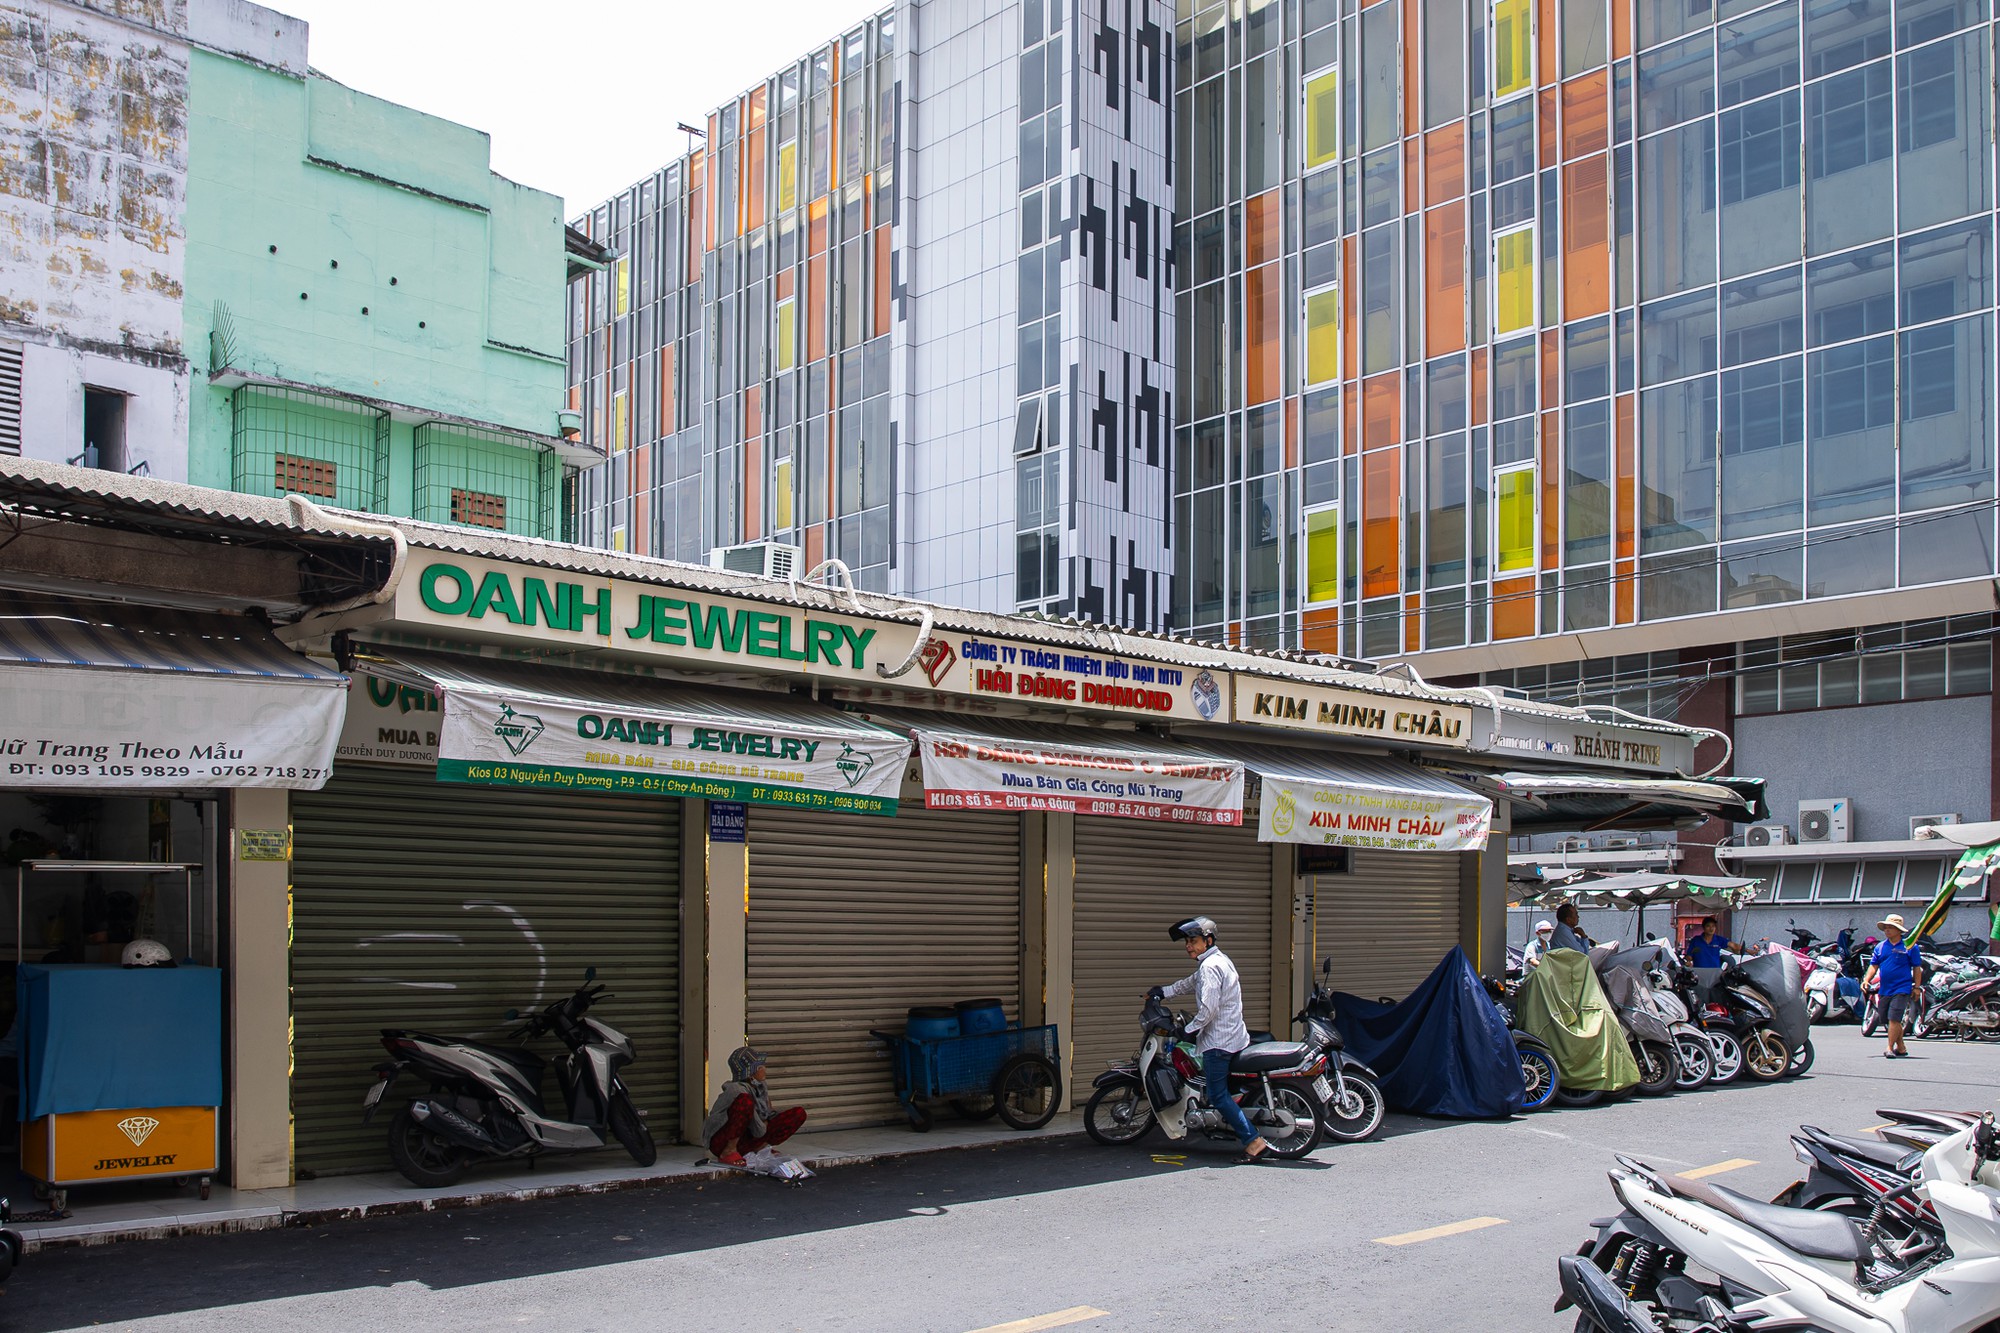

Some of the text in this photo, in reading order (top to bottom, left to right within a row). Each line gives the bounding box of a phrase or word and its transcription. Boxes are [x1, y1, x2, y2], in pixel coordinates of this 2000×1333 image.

[420, 563, 877, 670] OANH JEWELRY
[961, 640, 997, 662] CÔNG
[1000, 646, 1017, 665] TY
[1021, 648, 1061, 670] TRÁCH
[1063, 655, 1101, 678] NHIỆM
[1105, 656, 1129, 680] HỮU
[1132, 664, 1155, 686] HẠN
[976, 663, 1173, 712] HẢI ĐĂNG DIAMOND
[1253, 692, 1462, 739] KIM MINH CHÂU
[378, 727, 440, 747] MUA B
[494, 726, 524, 737] OANH
[577, 714, 821, 762] OANH JEWELRY
[37, 740, 110, 762] Trang
[119, 742, 181, 760] Theo
[189, 742, 243, 760] Mẫu
[376, 747, 396, 758] DUY
[399, 749, 435, 762] DƯƠNG,
[1535, 739, 1570, 755] Jewelry
[9, 763, 44, 776] ĐT:
[51, 764, 90, 776] 093
[98, 765, 134, 777] 105
[141, 766, 190, 778] 9829
[211, 766, 258, 777] 0762
[264, 766, 296, 778] 718
[585, 751, 621, 765] MUA
[625, 753, 653, 768] BÁN
[671, 759, 695, 771] GIA
[699, 760, 736, 776] CÔNG
[763, 769, 805, 783] TRANG
[1161, 761, 1234, 782] JEWELRY
[468, 766, 491, 779] Kios
[493, 767, 507, 779] 03
[510, 768, 550, 784] Nguyễn
[553, 771, 574, 787] Duy
[577, 773, 612, 789] Dương
[620, 776, 635, 788] P.9
[643, 778, 659, 791] Q.5
[667, 780, 688, 795] Chợ
[690, 783, 703, 794] An
[705, 784, 730, 799] Đông
[752, 788, 766, 799] ĐT
[772, 791, 793, 803] 0933
[795, 792, 810, 804] 631
[812, 794, 827, 805] 751
[853, 798, 869, 810] 900
[1002, 773, 1033, 788] Mua
[1036, 775, 1062, 790] Bán
[1065, 777, 1087, 792] Gia
[1091, 780, 1124, 797] Công
[1149, 785, 1183, 801] Trang
[983, 795, 993, 807] 5
[1006, 794, 1027, 810] Chợ
[1031, 796, 1046, 809] An
[1048, 797, 1076, 811] Đông
[1118, 803, 1131, 815] 55
[1134, 804, 1146, 817] 74
[1148, 806, 1161, 818] 09
[1313, 789, 1343, 805] CÔNG
[1345, 794, 1357, 806] TY
[1359, 795, 1383, 808] TNHH
[1424, 800, 1443, 813] QUÝ
[712, 811, 744, 828] HẢI ĐĂNG
[1309, 810, 1341, 829] KIM
[1347, 814, 1391, 833] MINH
[1397, 815, 1446, 836] CHÂU
[94, 1154, 177, 1170] JEWELRY
